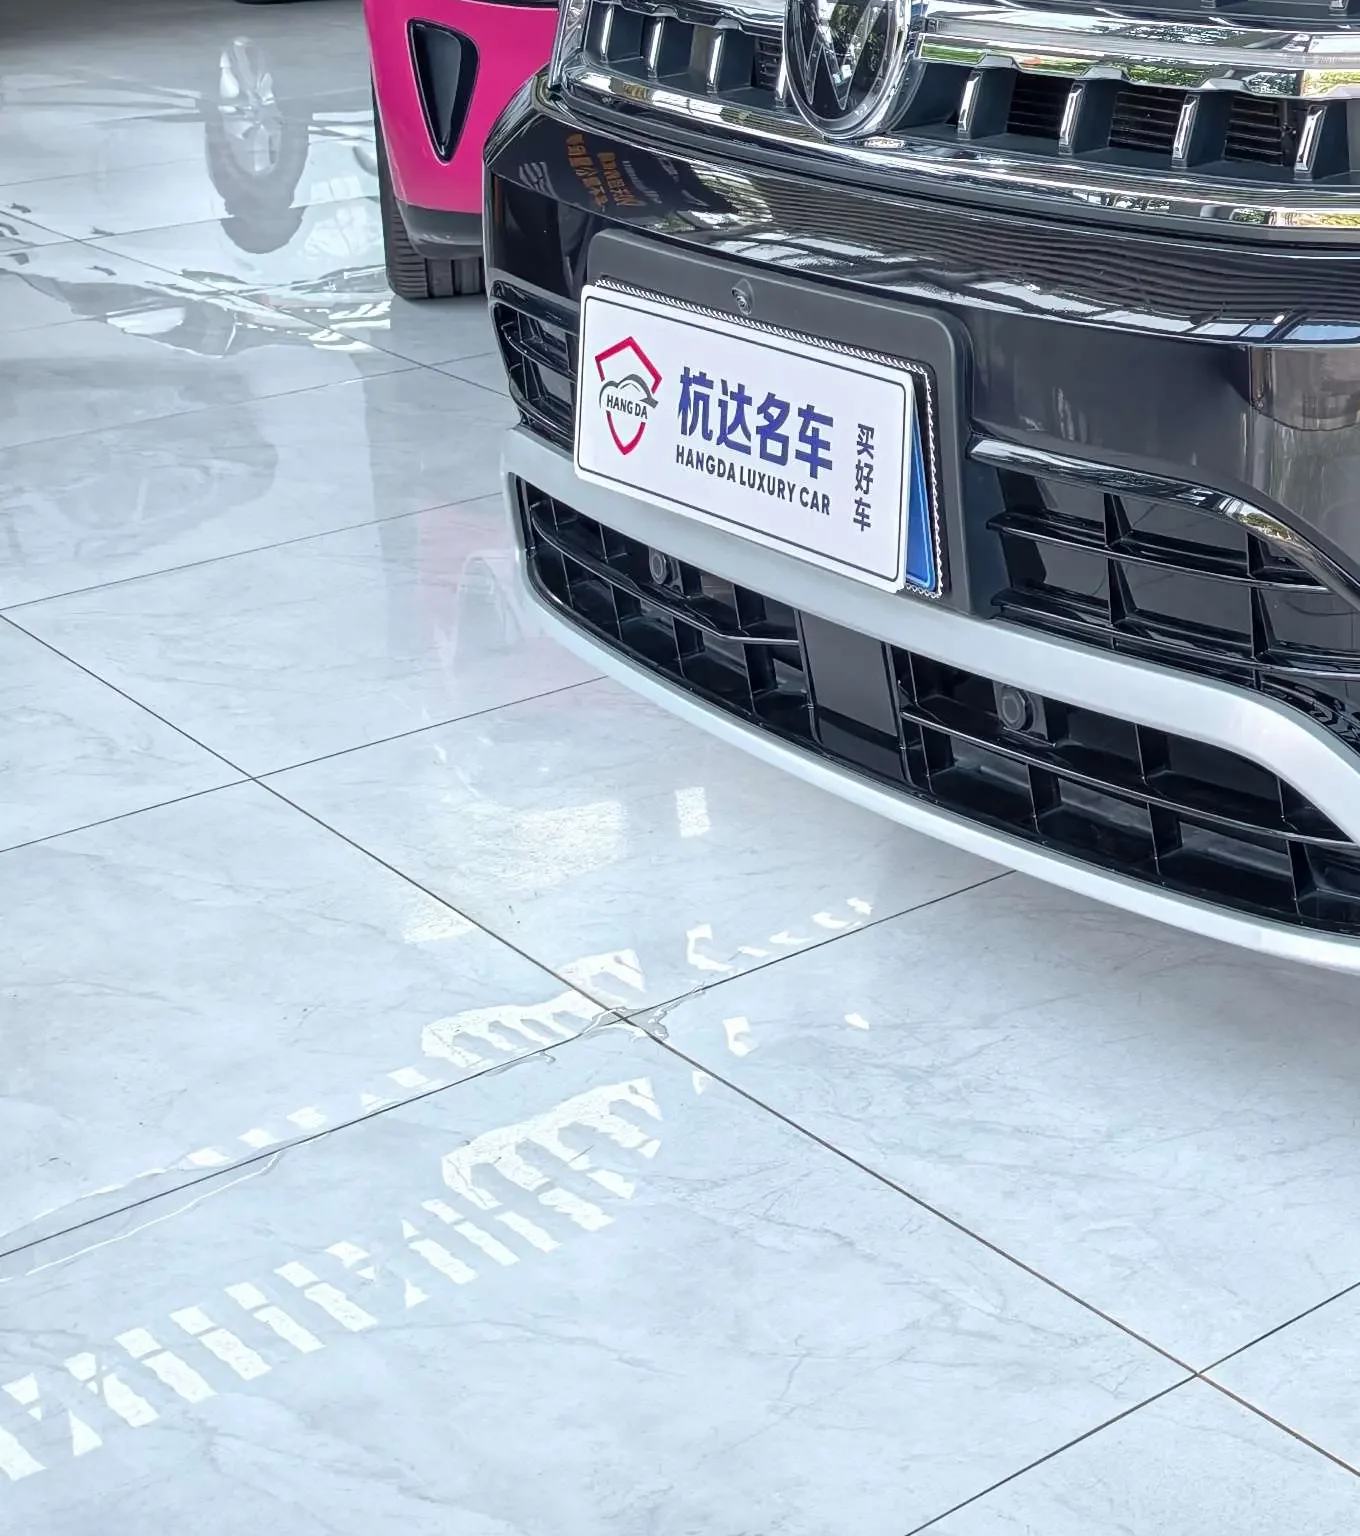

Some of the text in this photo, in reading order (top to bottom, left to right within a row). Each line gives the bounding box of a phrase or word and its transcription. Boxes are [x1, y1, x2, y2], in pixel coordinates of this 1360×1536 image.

[606, 392, 648, 420] HANG DA
[677, 366, 833, 479] 杭达名车
[675, 444, 831, 516] HANGDA LUXURY CAR
[852, 422, 874, 532] 买好车
